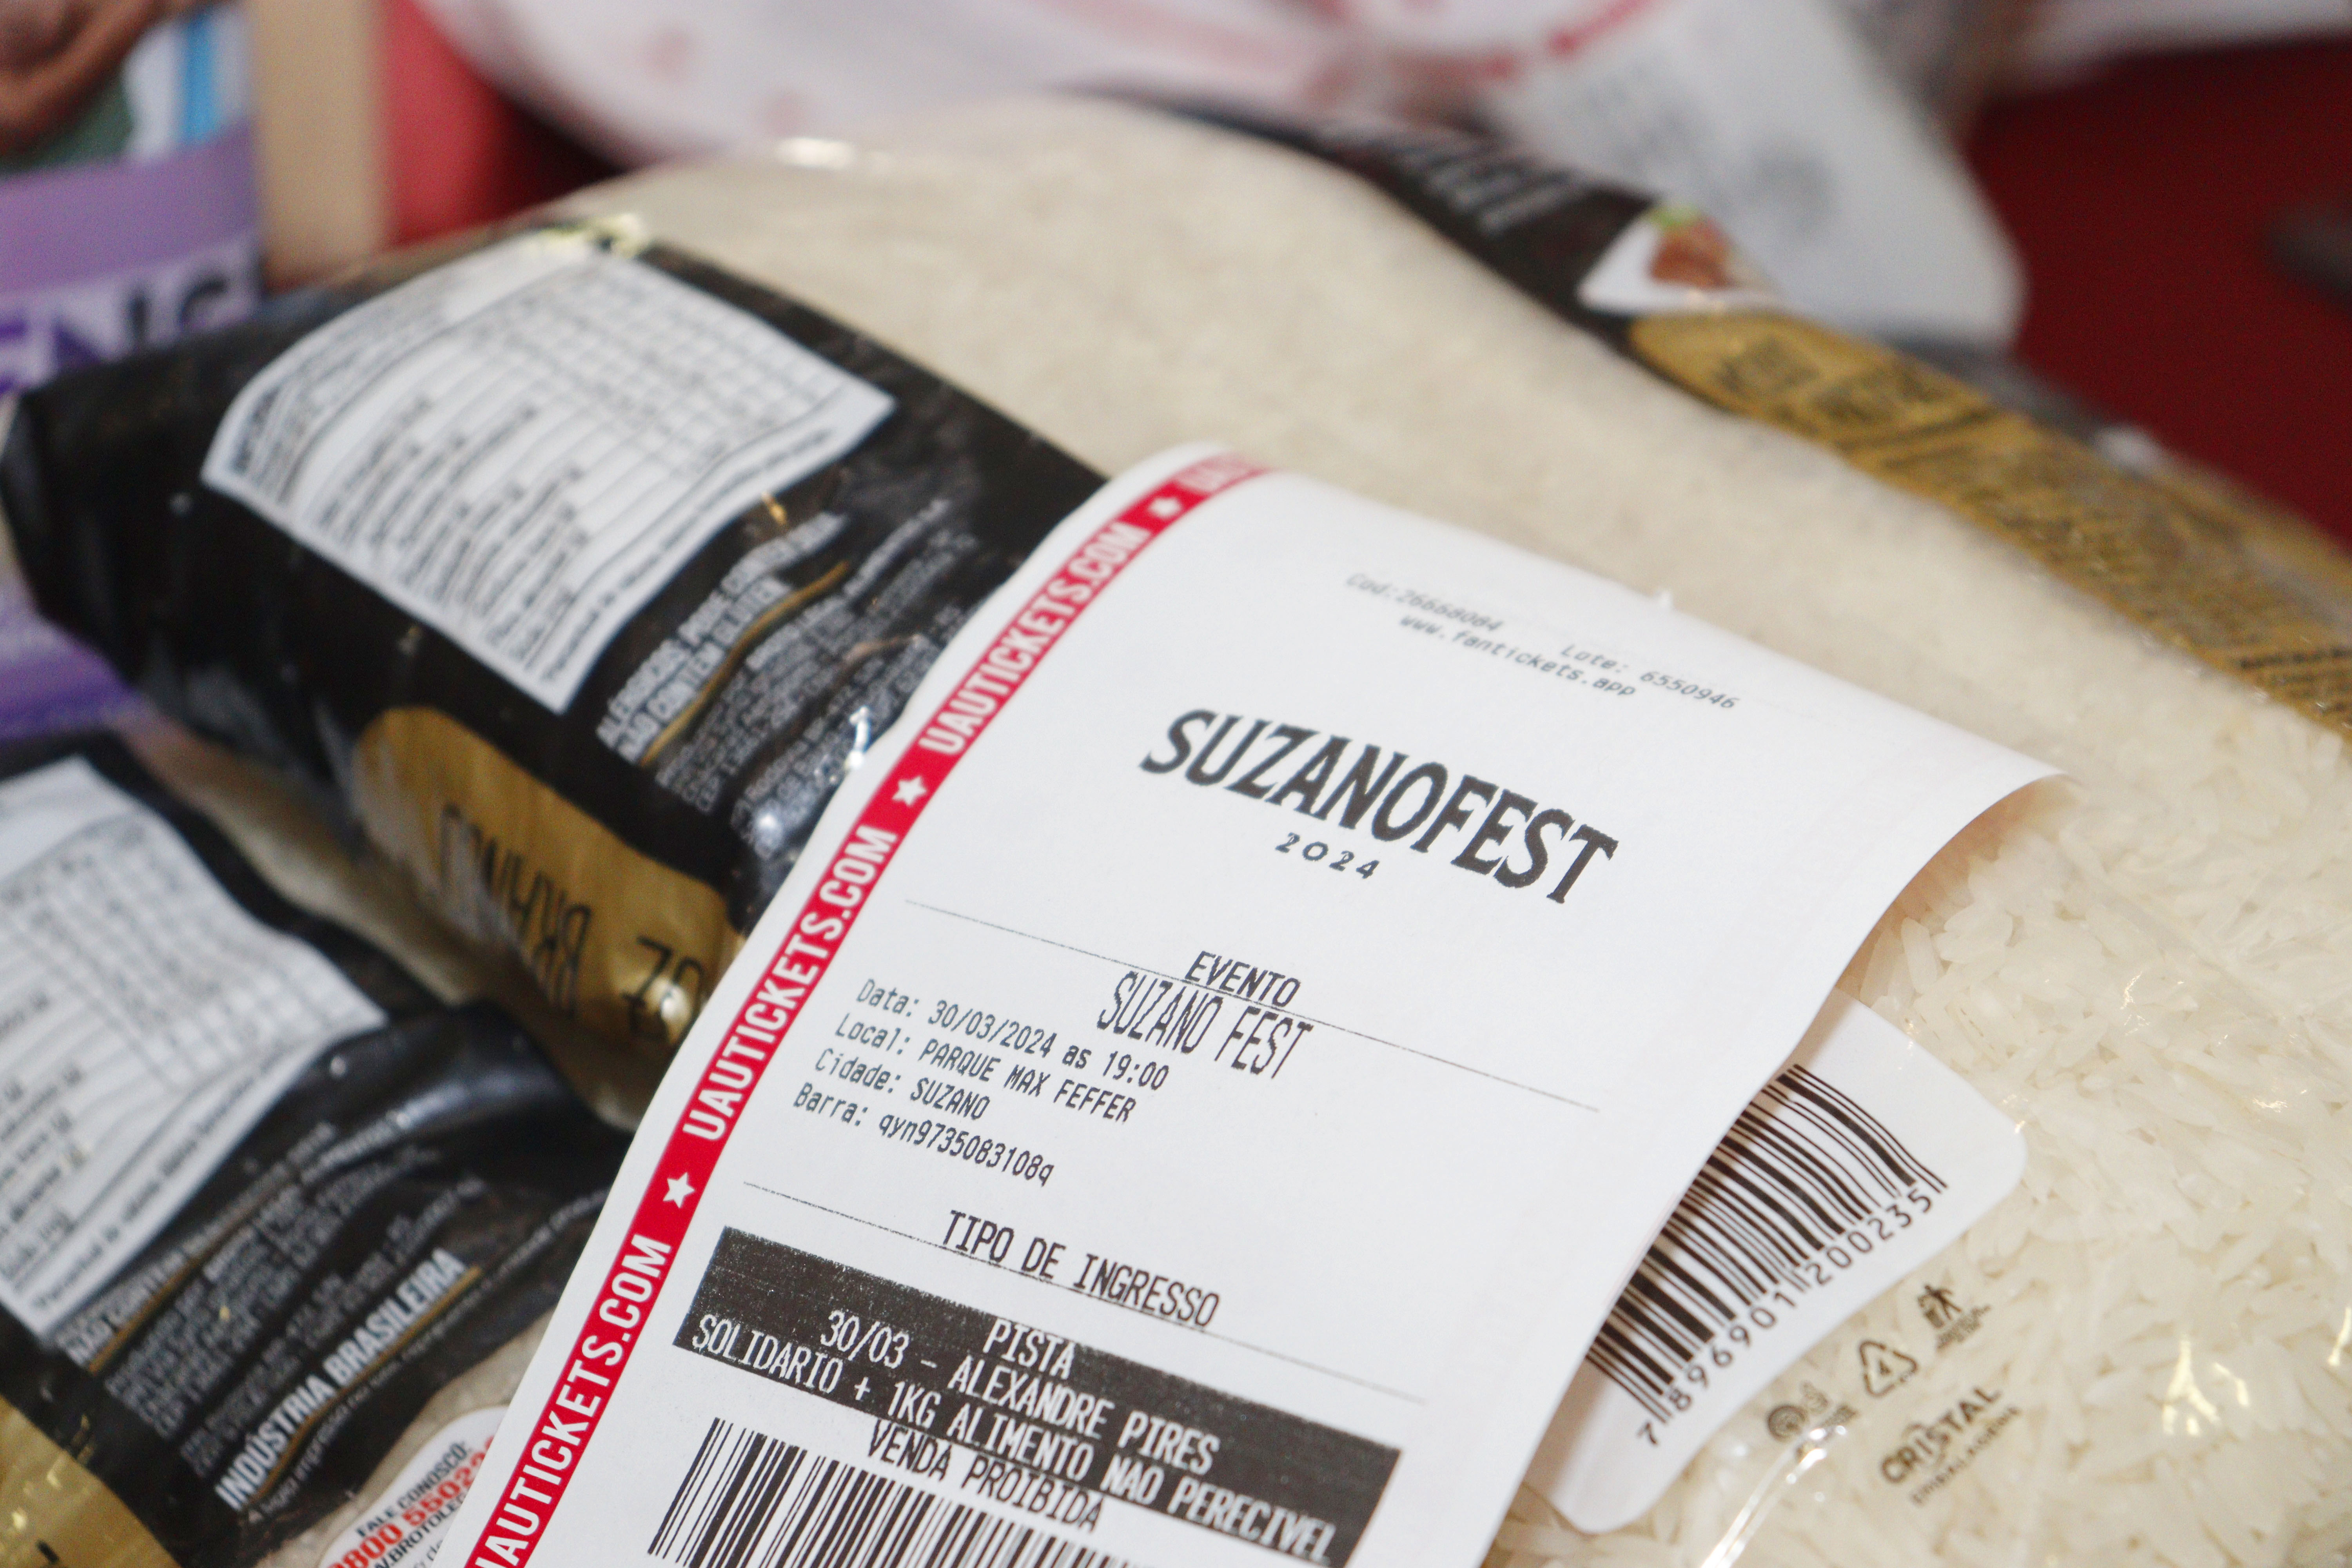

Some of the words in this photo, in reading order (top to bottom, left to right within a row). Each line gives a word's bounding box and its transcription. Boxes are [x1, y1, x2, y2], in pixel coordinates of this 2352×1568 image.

[918, 522, 1151, 755] UAUTICKETS.COM
[1400, 615, 1637, 698] www.fantickets.app
[1640, 669, 1740, 709] 6550946
[1139, 710, 1619, 904] SUZANOFEST
[1276, 832, 1380, 879] 2024
[683, 825, 897, 1141] UAUTICKETS.COM
[1096, 971, 1223, 1055] SUZANO
[1215, 1006, 1313, 1080] FEST
[1185, 950, 1301, 1007] EVENTO
[814, 1047, 901, 1094] Cidade:
[910, 1077, 991, 1121] SUZANO
[835, 1012, 911, 1055] Local:
[919, 1043, 1001, 1083] PARQUE
[1005, 1068, 1048, 1097] MAX
[1054, 1083, 1137, 1124] FEFFER
[857, 978, 918, 1017] Data:
[928, 1000, 1056, 1057] 30/03/2024
[1062, 1042, 1091, 1069] as
[1102, 1054, 1169, 1091] 19:00
[794, 1082, 867, 1127] Barra:
[942, 1210, 1017, 1266] TIPO
[1021, 1237, 1067, 1280] DE
[1074, 1252, 1221, 1328] INGRESSO
[216, 1374, 336, 1509] INDÚSTRIA
[322, 1246, 467, 1386] BRASILEIRA
[818, 1310, 913, 1370] 30/03
[949, 1356, 1115, 1441] ALEXANDRE
[1117, 1408, 1223, 1474] PIRES
[982, 1313, 1077, 1381] PISTA
[691, 1315, 848, 1399] SOLIDARIO
[853, 1377, 871, 1402] +
[884, 1381, 943, 1428] 1KG
[946, 1401, 1095, 1486] ALIMENTO
[1099, 1451, 1166, 1507] NAO
[1174, 1474, 1339, 1564] PERECIVEL
[866, 1419, 951, 1483] VENDA
[959, 1454, 1105, 1532] PROIBIDA
[1882, 1387, 2002, 1484] CRISTAL
[356, 1506, 397, 1537] FALE
